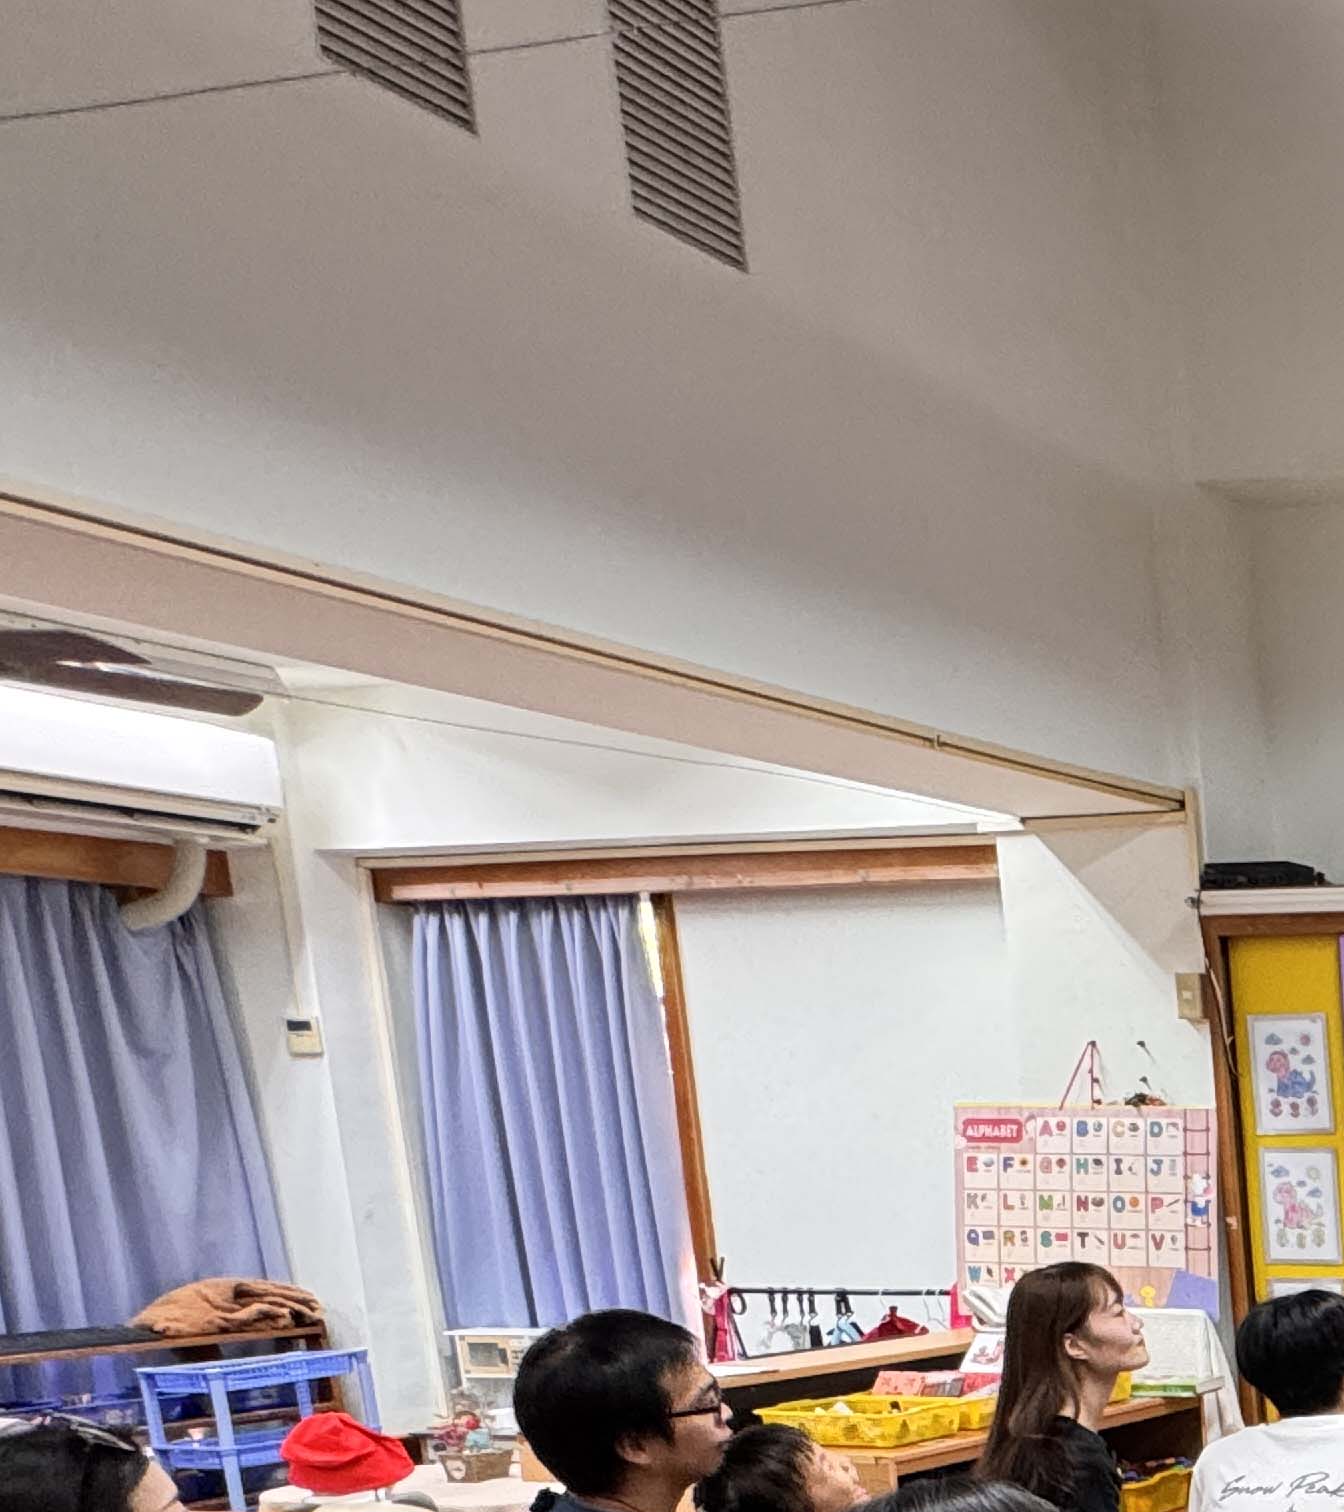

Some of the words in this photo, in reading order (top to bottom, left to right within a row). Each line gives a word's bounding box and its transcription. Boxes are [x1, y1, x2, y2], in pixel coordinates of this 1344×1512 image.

[966, 1124, 1018, 1138] ALPHABET
[1039, 1120, 1053, 1137] A
[1076, 1120, 1089, 1138] B
[1112, 1120, 1126, 1138] C
[1149, 1121, 1163, 1138] D
[966, 1156, 978, 1173] E
[1002, 1156, 1015, 1174] F
[1075, 1158, 1089, 1176] H
[1113, 1157, 1124, 1176] I
[1149, 1158, 1164, 1177] J
[966, 1192, 979, 1209] K
[1002, 1193, 1015, 1210] L
[1039, 1194, 1054, 1211] M
[1076, 1194, 1089, 1212] N
[1112, 1195, 1126, 1213] O
[1150, 1196, 1164, 1214] P
[966, 1228, 980, 1247] Q
[1002, 1230, 1015, 1247] R
[1040, 1230, 1053, 1248] S
[1076, 1231, 1089, 1249] T
[1112, 1231, 1126, 1250] U
[1150, 1232, 1165, 1251] V
[967, 1265, 982, 1283] W
[1004, 1266, 1016, 1284] X
[1219, 1474, 1283, 1502] Snow
